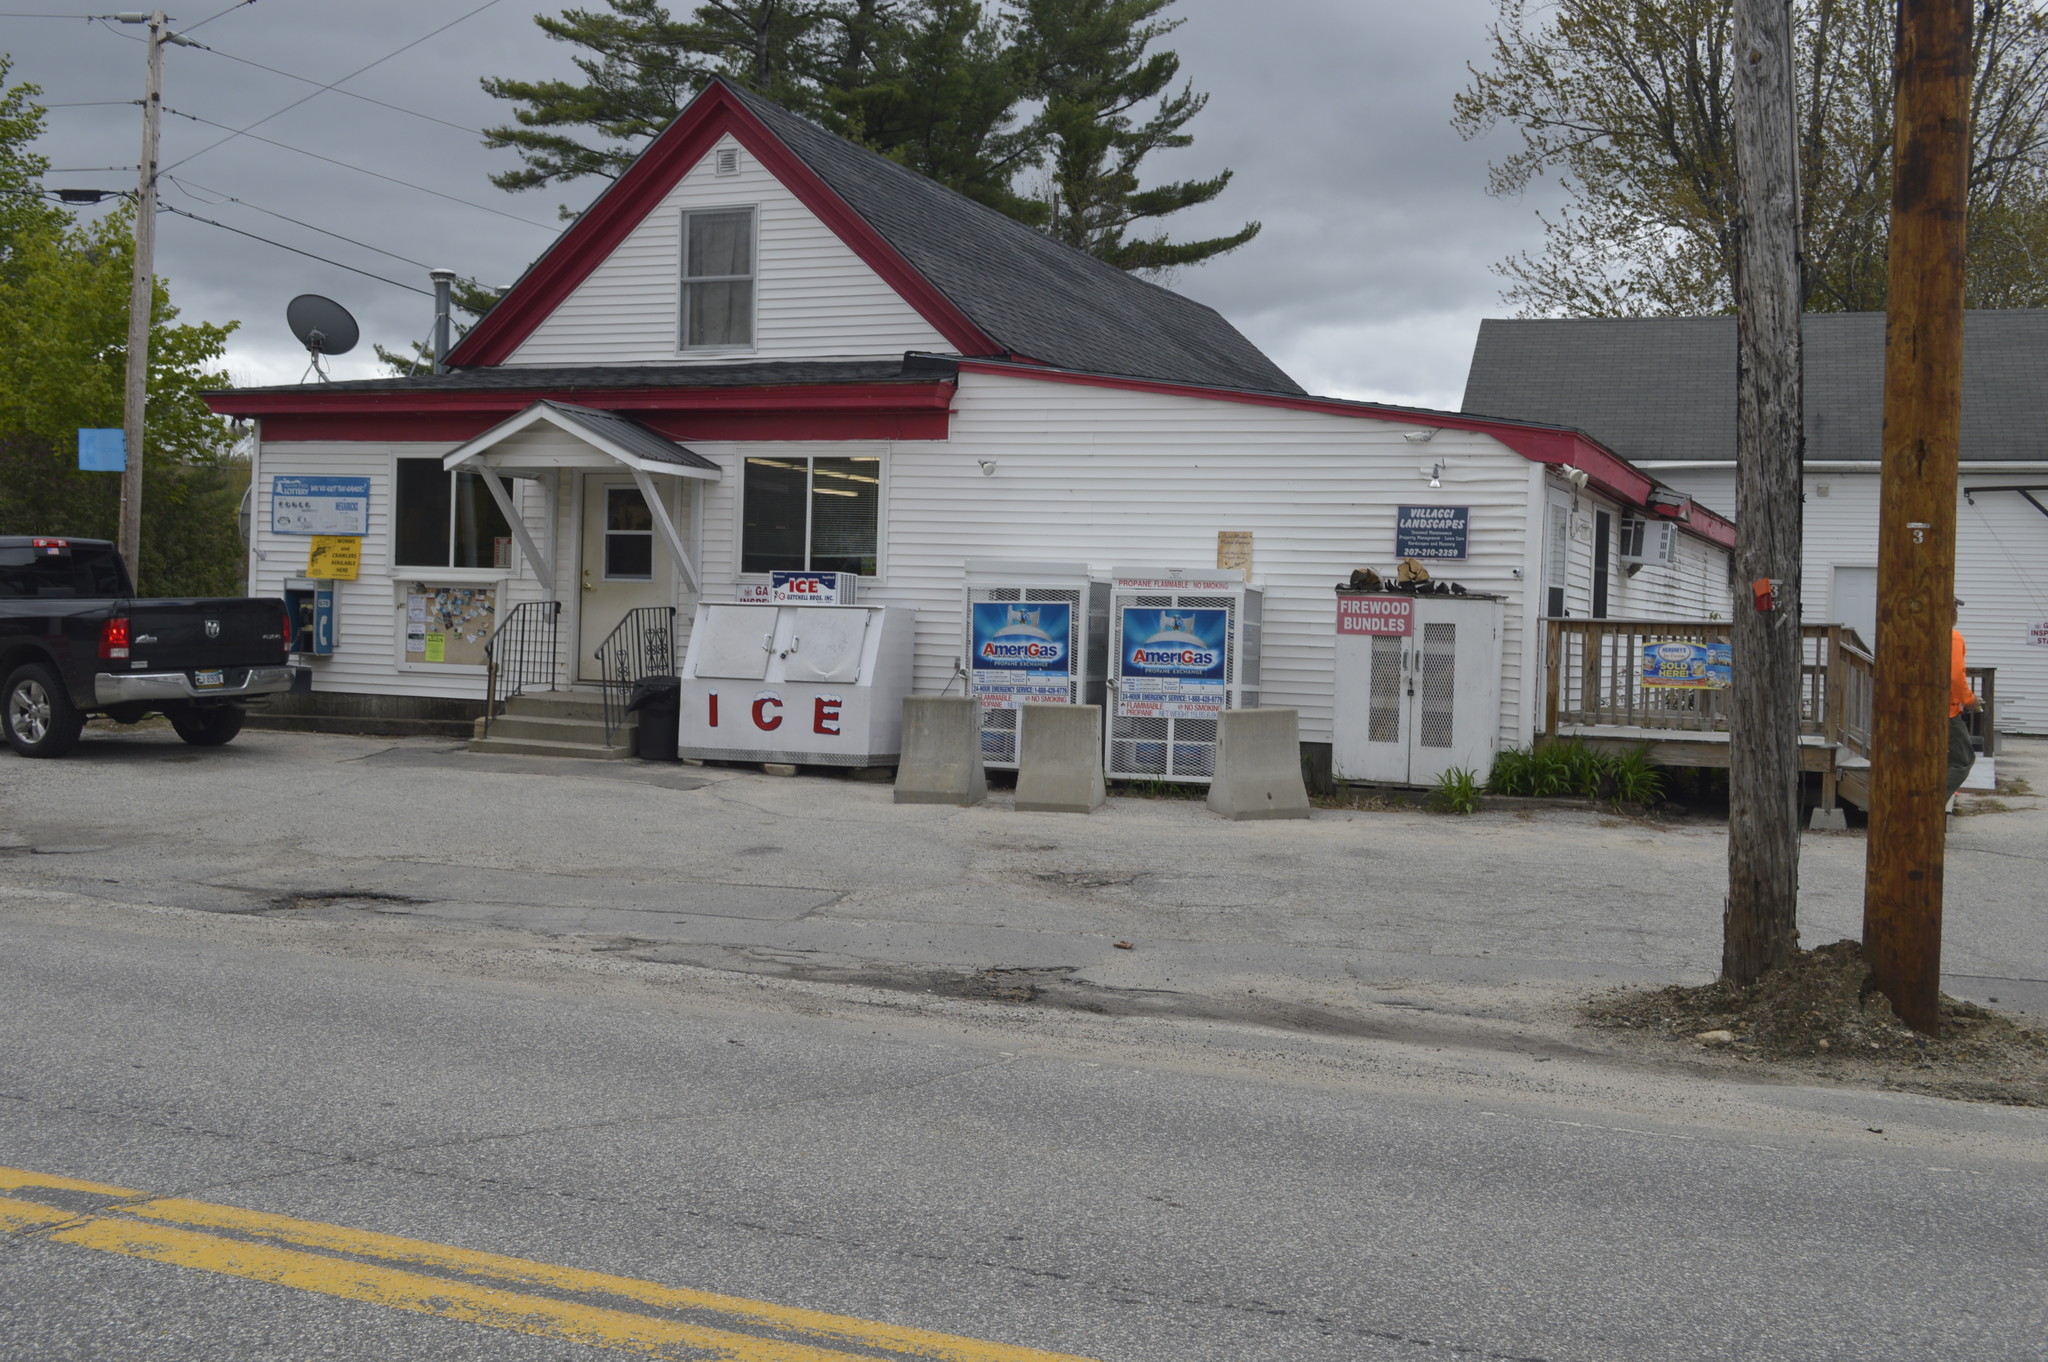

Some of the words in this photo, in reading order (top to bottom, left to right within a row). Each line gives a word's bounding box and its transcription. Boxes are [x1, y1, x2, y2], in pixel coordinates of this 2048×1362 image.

[1400, 518, 1466, 530] LANDSCAPES
[1912, 529, 1924, 544] 3
[1404, 548, 1459, 557] 207-210-2359
[789, 577, 819, 593] ICE
[1119, 579, 1151, 588] PROPANE
[1154, 580, 1188, 588] FLAMMABLE
[1340, 600, 1410, 615] FIREWOOD
[1343, 617, 1405, 632] BUNDLES
[983, 643, 1058, 657] AmeriGas
[1133, 650, 1213, 665] AmeriGas
[1660, 661, 1688, 670] SOLD
[973, 685, 991, 693] 24-HOUR
[708, 688, 842, 735] ICE
